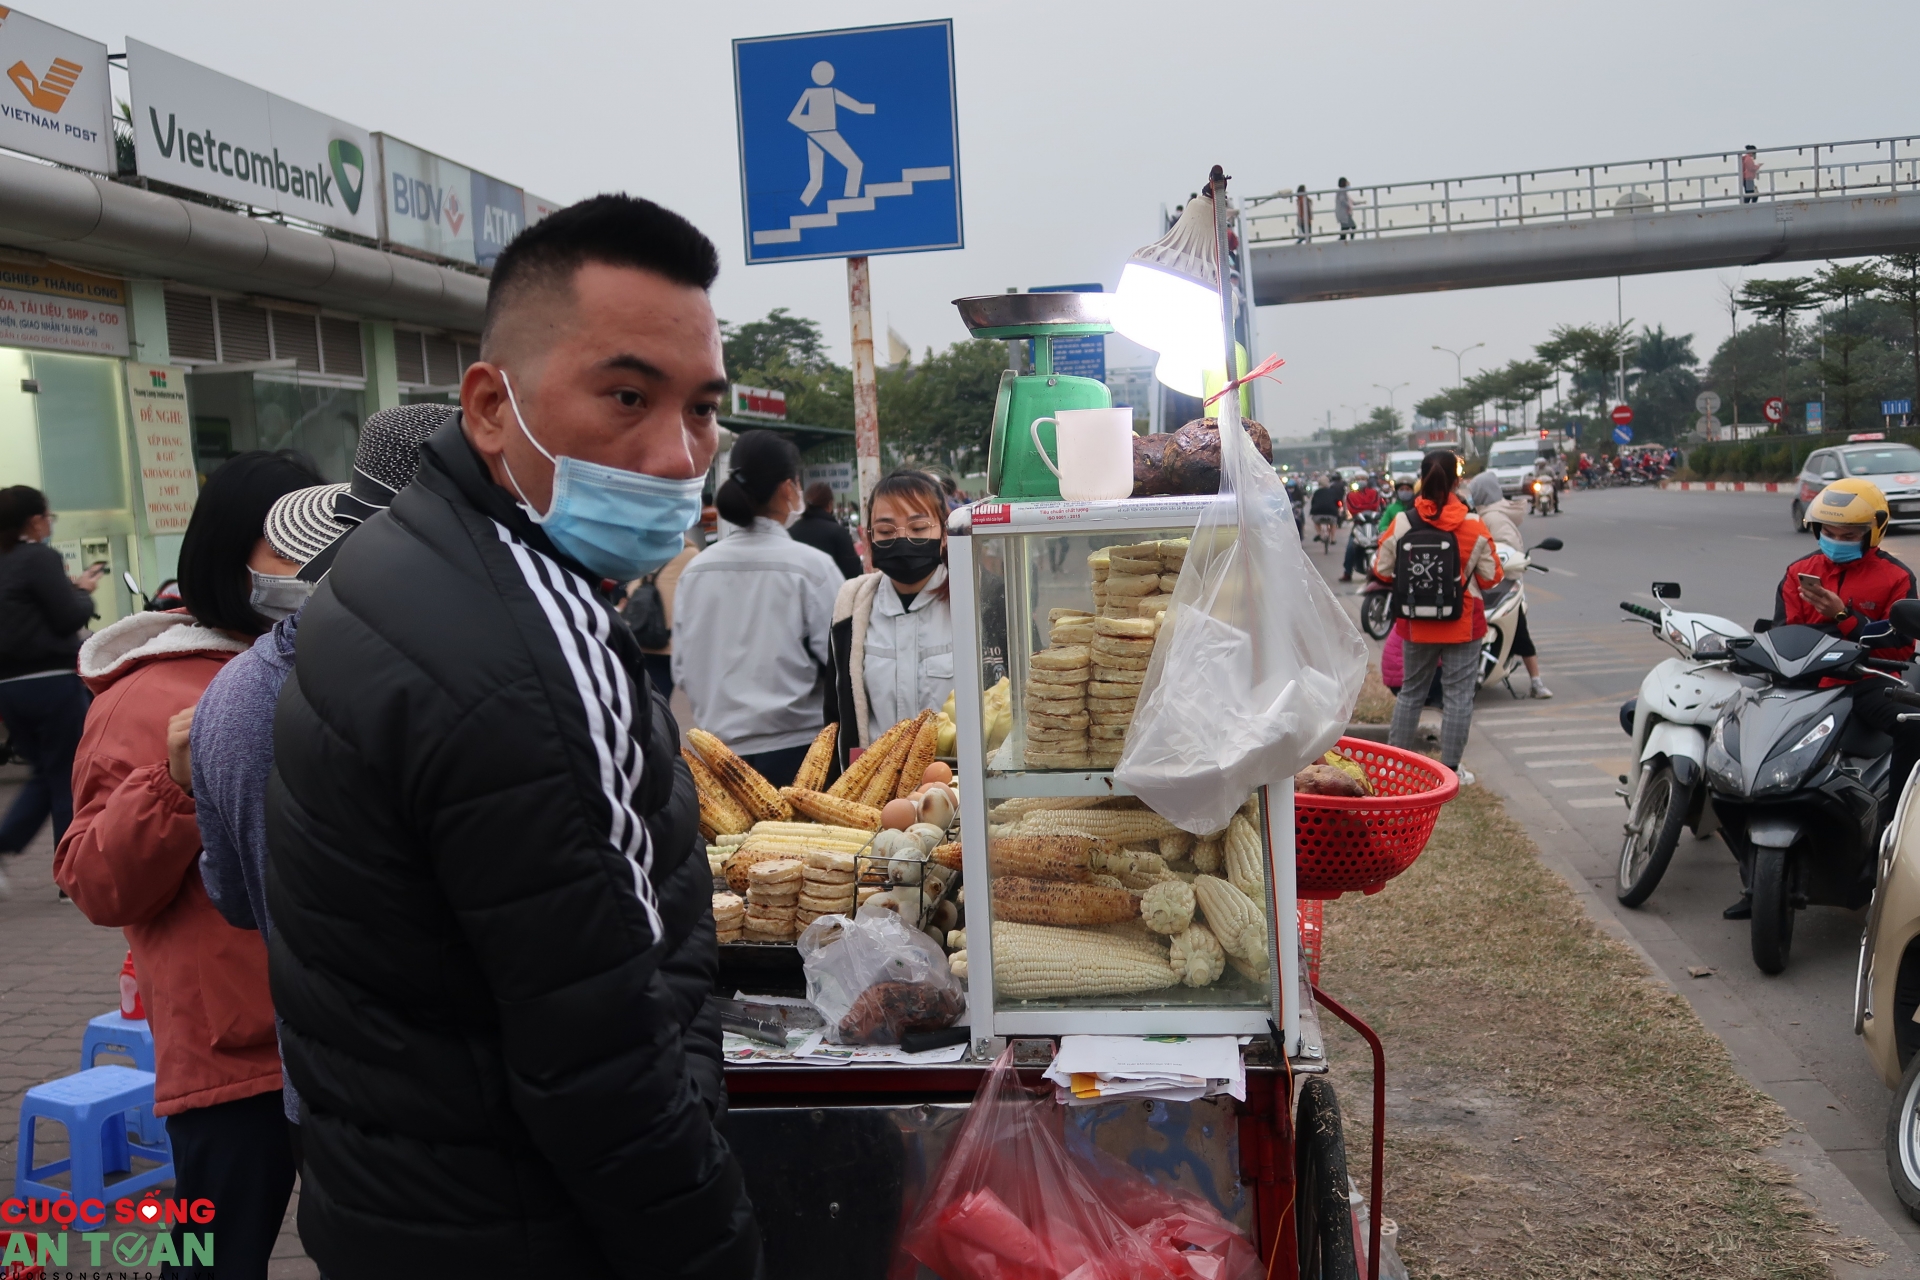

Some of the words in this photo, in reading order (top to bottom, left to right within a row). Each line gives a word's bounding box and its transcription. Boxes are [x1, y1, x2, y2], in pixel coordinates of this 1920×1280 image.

[1, 104, 60, 133] VIETNAM
[64, 124, 98, 144] POST
[148, 105, 334, 208] Vietcombank
[392, 171, 444, 226] BIDV
[483, 204, 518, 247] ATM
[0, 270, 39, 288] GHIỆP
[87, 284, 118, 300] LONG
[66, 307, 88, 321] SHIP
[98, 312, 119, 326] COD
[140, 403, 154, 423] ĐỀ
[155, 517, 188, 530] COVID-19
